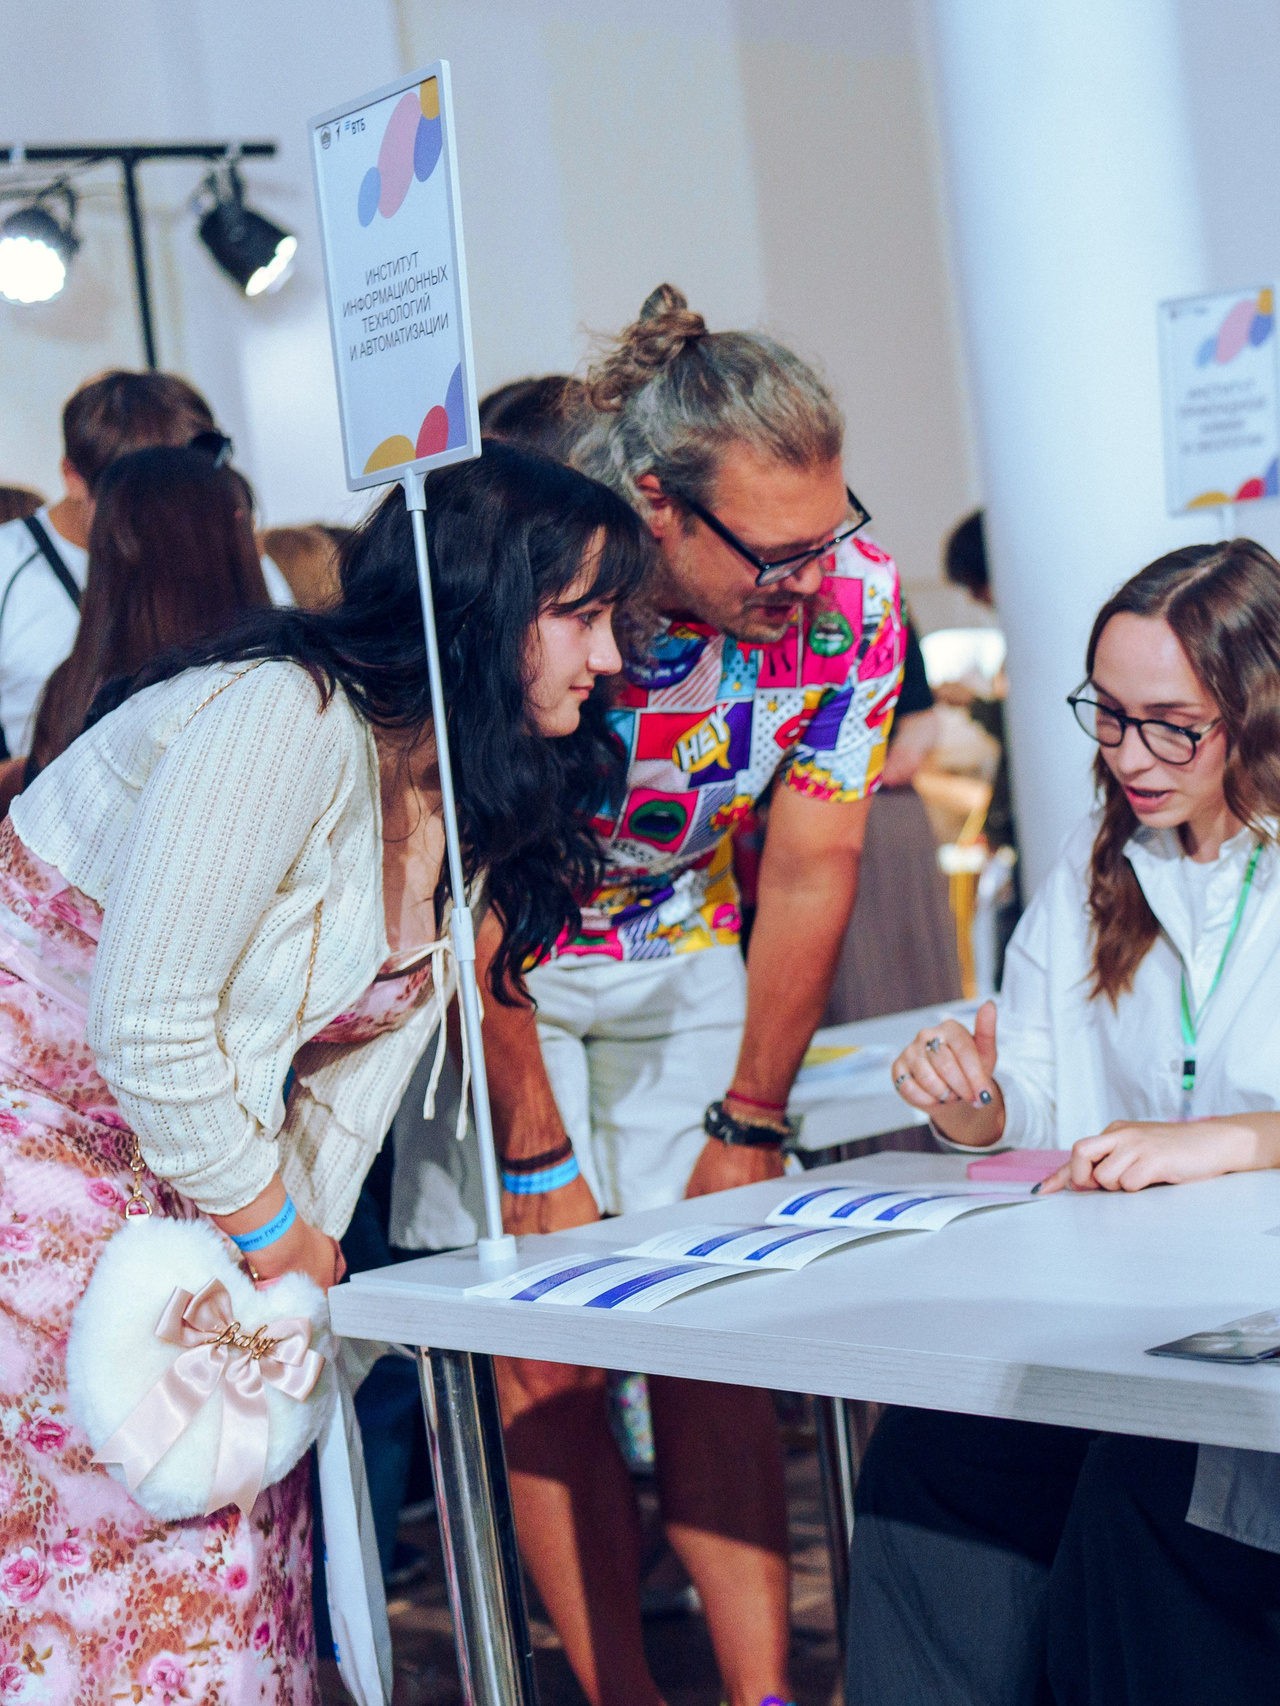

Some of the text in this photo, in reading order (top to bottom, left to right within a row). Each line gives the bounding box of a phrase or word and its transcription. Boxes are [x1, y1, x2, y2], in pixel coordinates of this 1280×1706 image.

[351, 117, 366, 135] ВТБ
[365, 251, 419, 286] ИНСТИТУТ
[342, 264, 448, 318] ИНФОРМАЦИОННЫХ
[361, 291, 431, 333] ТЕХНОЛОГИЙ
[349, 312, 449, 362] И АВТОМАТИЗАЦИИ
[676, 704, 728, 772] HEY
[206, 1321, 284, 1360] Baby
